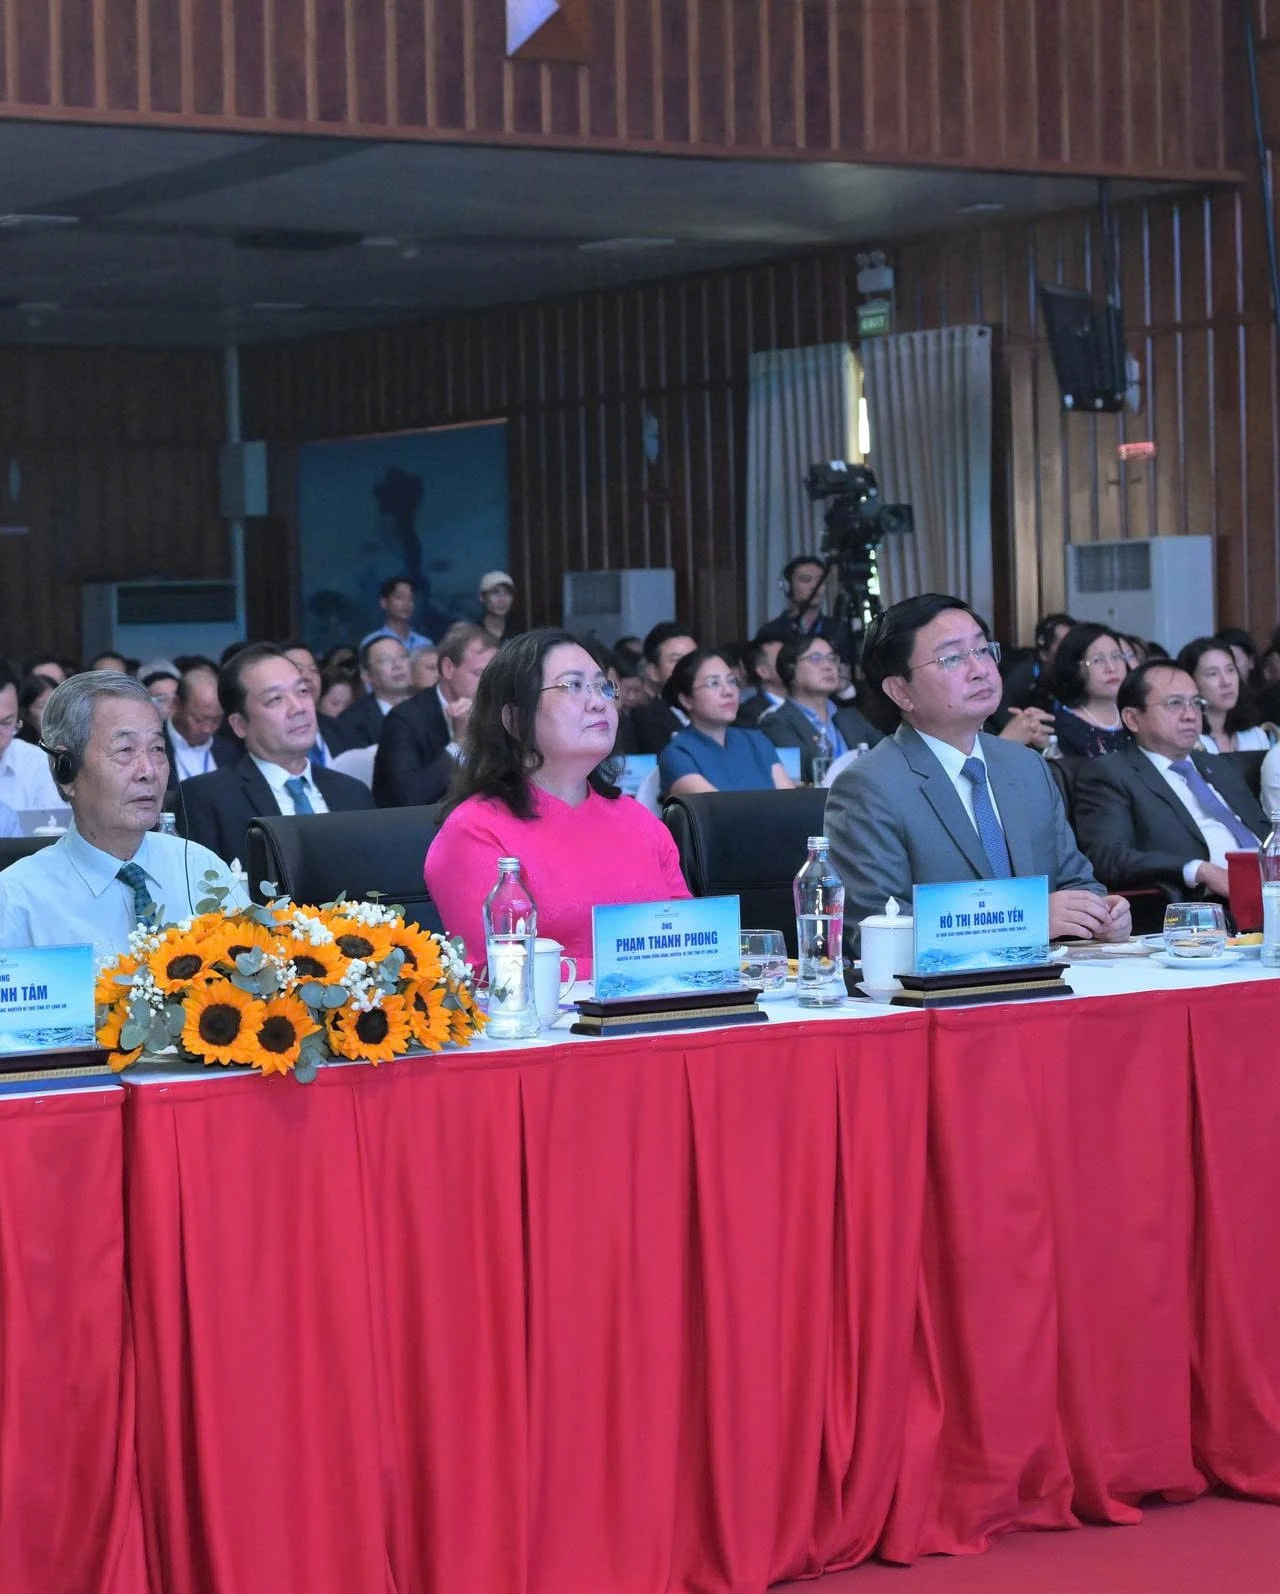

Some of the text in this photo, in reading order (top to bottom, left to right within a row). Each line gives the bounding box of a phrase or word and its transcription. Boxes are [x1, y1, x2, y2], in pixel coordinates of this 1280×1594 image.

[661, 922, 673, 930] ÔNG
[939, 905, 1024, 929] HỒ THỊ HOÀNG YẾN
[616, 931, 718, 954] PHẠM THANH PHONG
[21, 982, 48, 1002] TÂM
